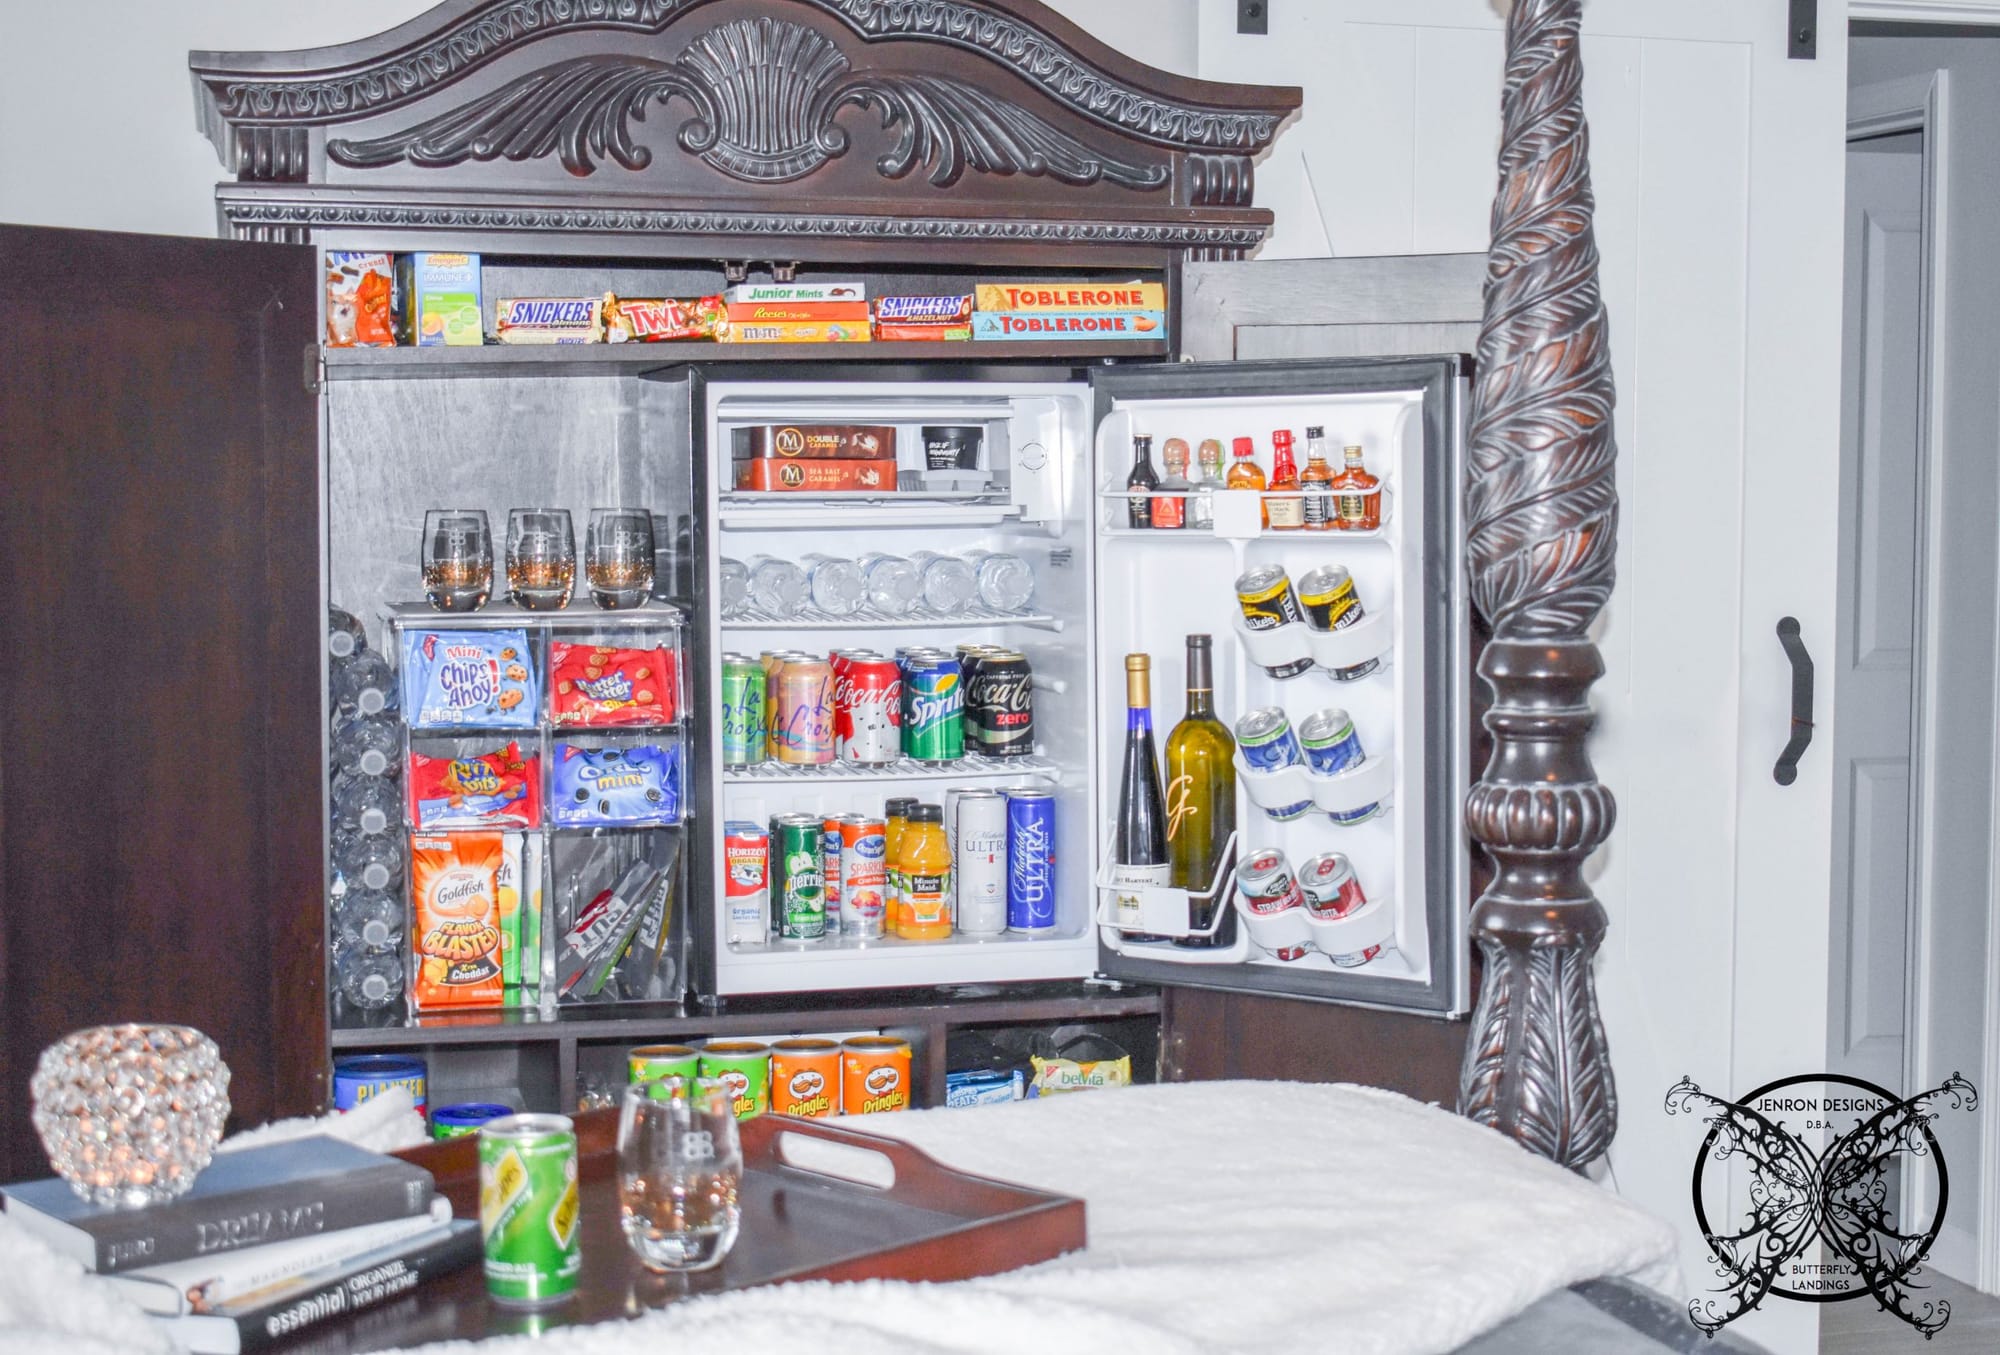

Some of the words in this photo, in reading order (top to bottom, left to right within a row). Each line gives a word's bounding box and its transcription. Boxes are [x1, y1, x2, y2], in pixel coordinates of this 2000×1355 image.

[748, 287, 793, 299] Junior
[796, 289, 823, 298] Mints
[1006, 288, 1144, 307] TOBLERONE
[511, 301, 594, 324] SNICKERS
[881, 297, 962, 317] SNICKERS
[999, 315, 1126, 333] TOBLERONE
[806, 435, 840, 443] DOUBLE
[446, 646, 482, 659] Mini
[440, 661, 488, 690] Chips
[575, 671, 623, 692] Nutter
[996, 712, 1029, 725] zero
[598, 774, 643, 790] mini
[727, 847, 767, 857] HORIZON
[1027, 817, 1045, 903] ULTRA
[437, 879, 484, 904] Goldfish
[580, 908, 623, 945] CUT
[423, 926, 499, 962] BLASTED
[452, 966, 490, 980] Cheddar
[788, 1095, 829, 1116] Pringles
[864, 1090, 903, 1114] Pringles
[197, 1202, 324, 1253] DREAMS
[350, 1260, 407, 1291] ORGANIZE
[352, 1285, 385, 1307] YOUR
[386, 1270, 419, 1295] HOME
[266, 1286, 346, 1337] essential
